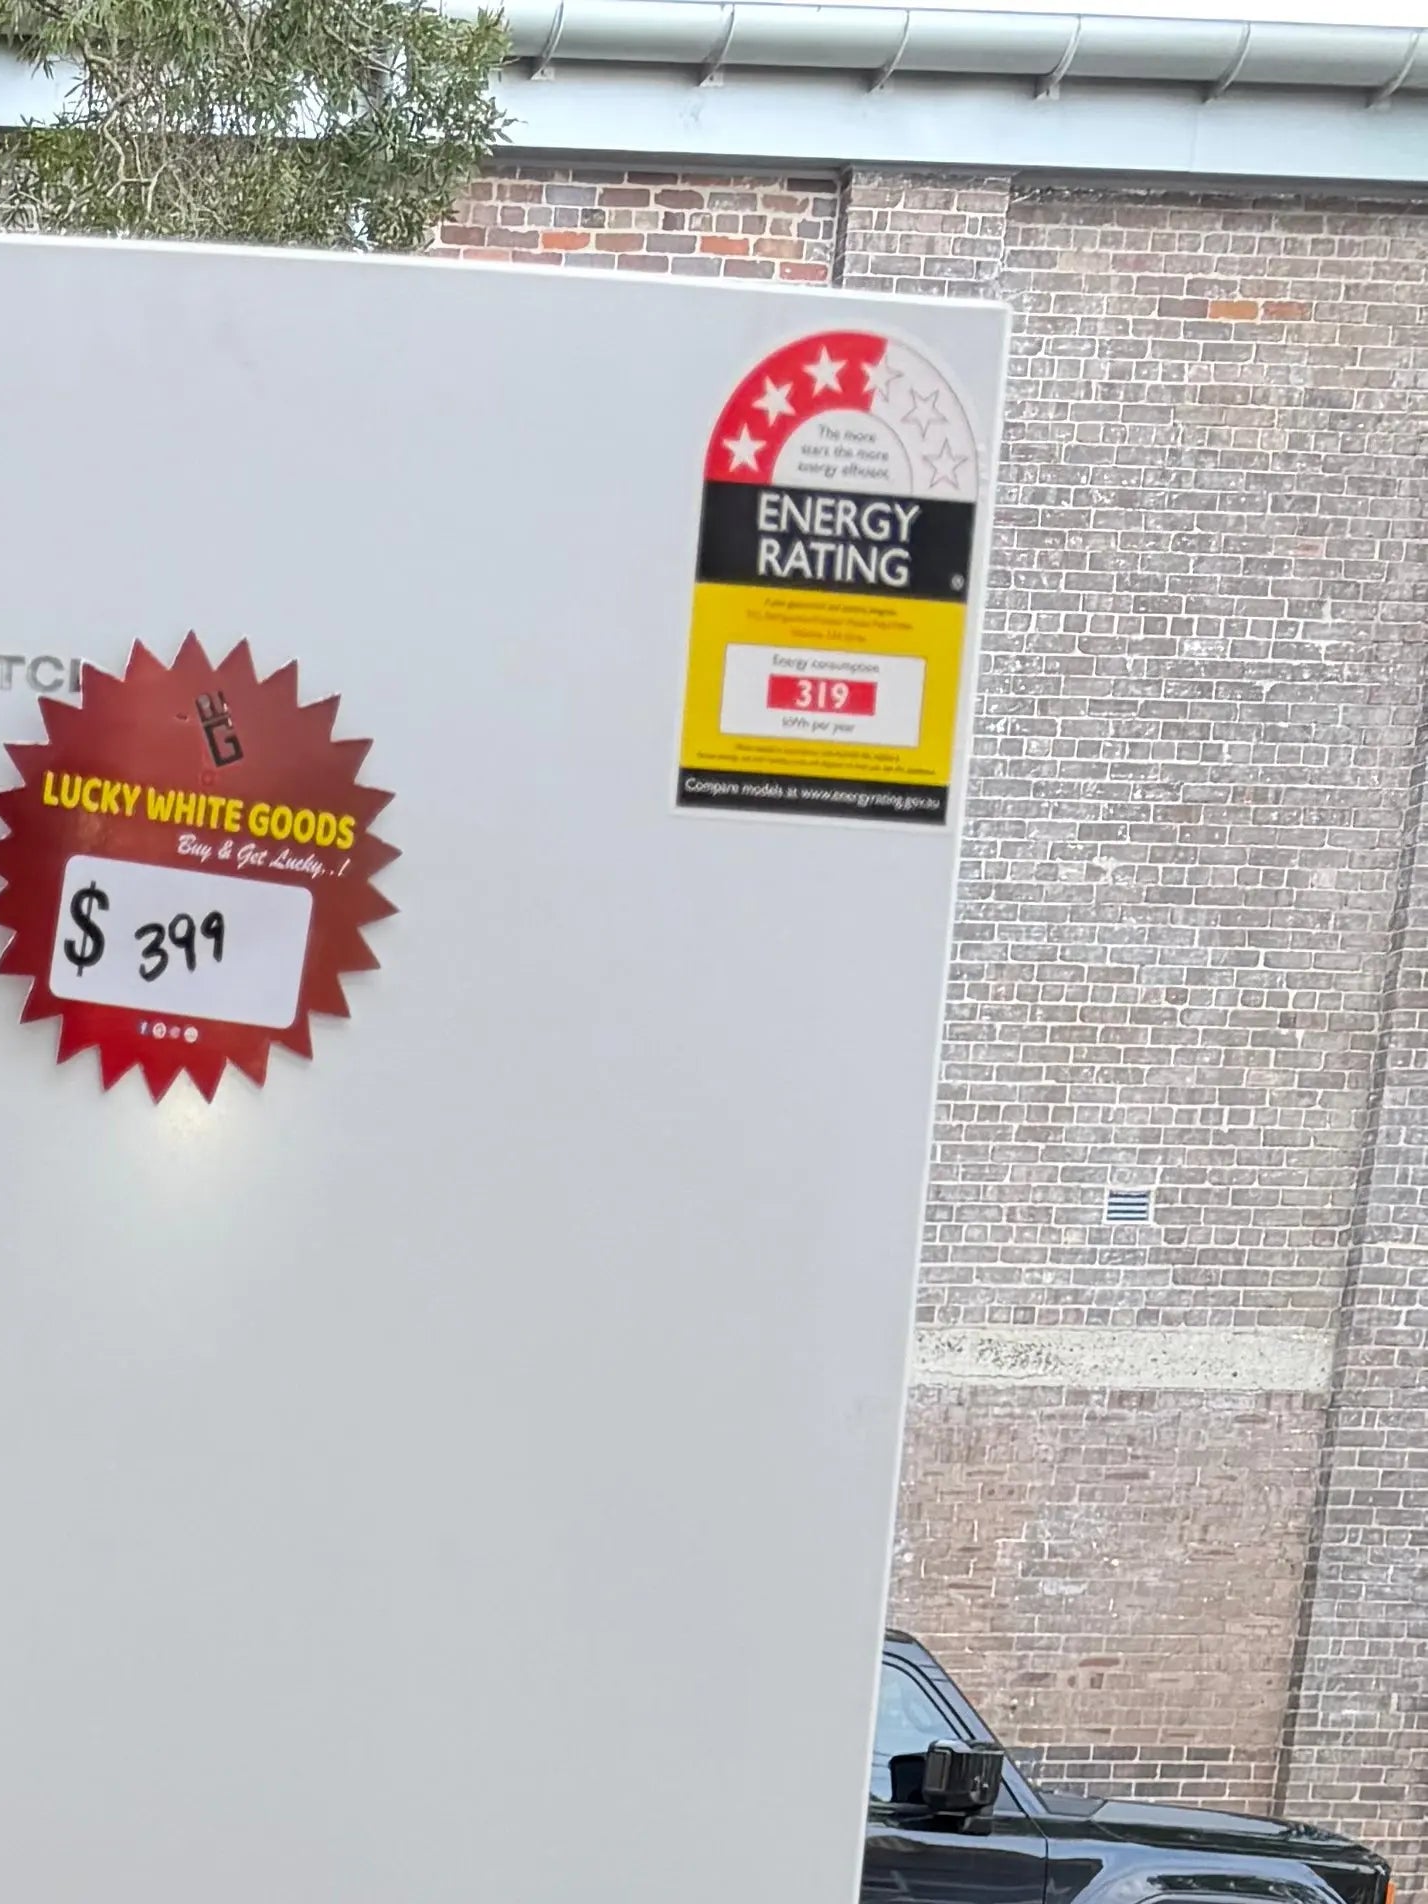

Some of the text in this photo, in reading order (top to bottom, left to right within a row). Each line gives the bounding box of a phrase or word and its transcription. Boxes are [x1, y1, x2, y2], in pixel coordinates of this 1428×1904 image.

[757, 491, 921, 543] ENERGY
[757, 537, 912, 588] RATING
[772, 653, 809, 671] Energy
[795, 679, 850, 709] 319
[812, 720, 830, 733] per
[685, 777, 739, 797] Compare
[742, 783, 784, 799] models
[787, 787, 799, 799] at
[42, 770, 357, 850] LUCKY WHITE GOODS
[176, 833, 212, 864] Buy
[218, 839, 234, 861] &
[236, 843, 268, 870] Get
[63, 880, 225, 983] $ 399
